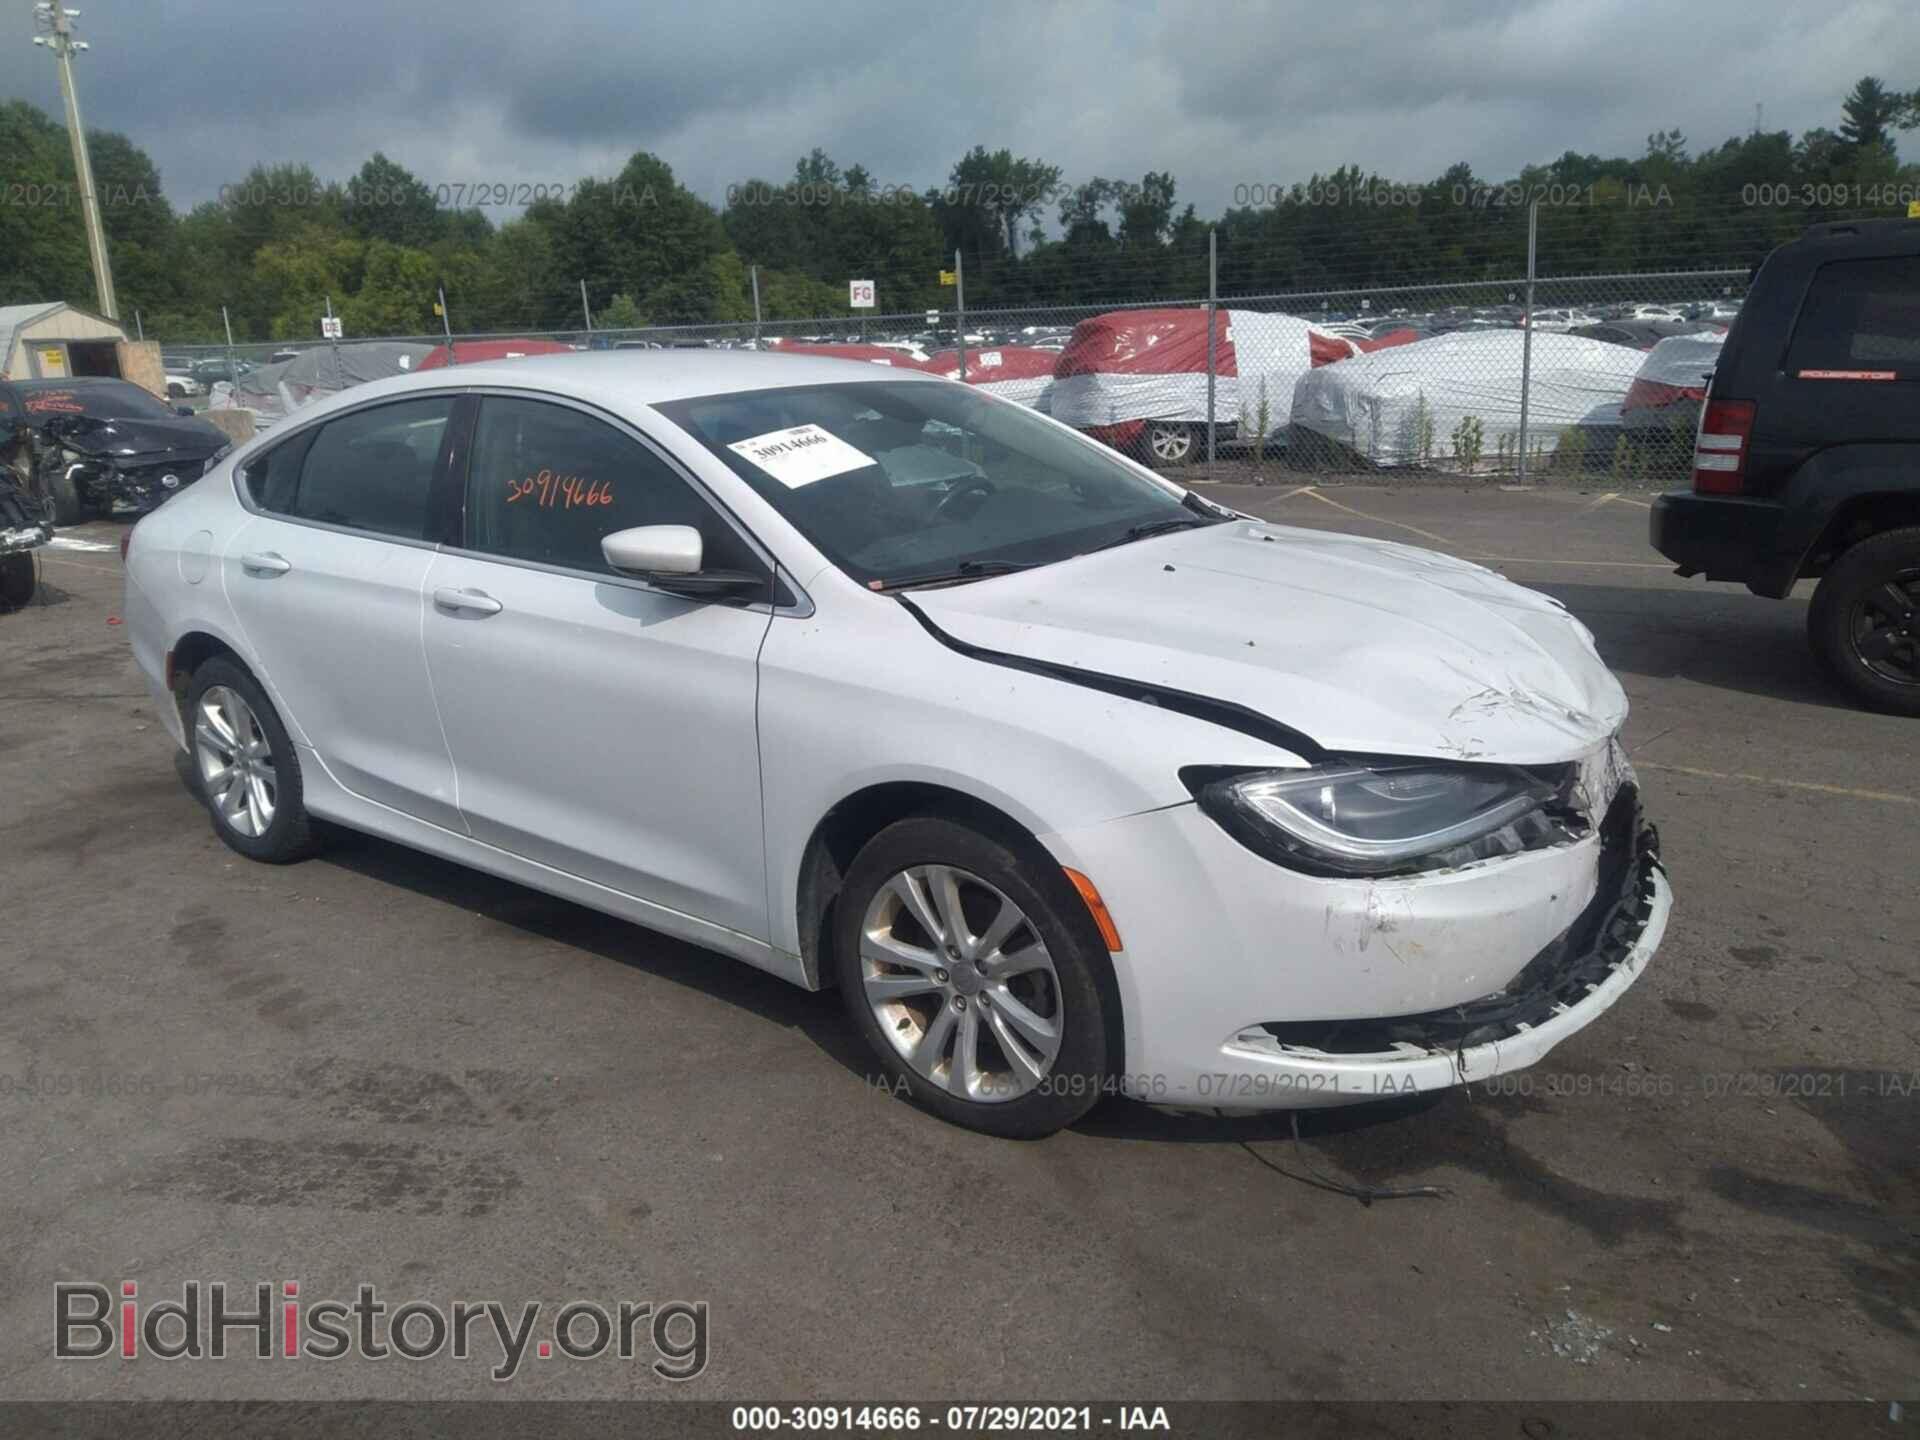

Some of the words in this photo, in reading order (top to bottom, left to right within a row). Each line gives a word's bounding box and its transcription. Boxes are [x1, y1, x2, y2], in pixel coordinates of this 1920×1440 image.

[853, 287, 872, 300] FG
[752, 434, 828, 460] 30914666
[507, 469, 613, 509] 30914666
